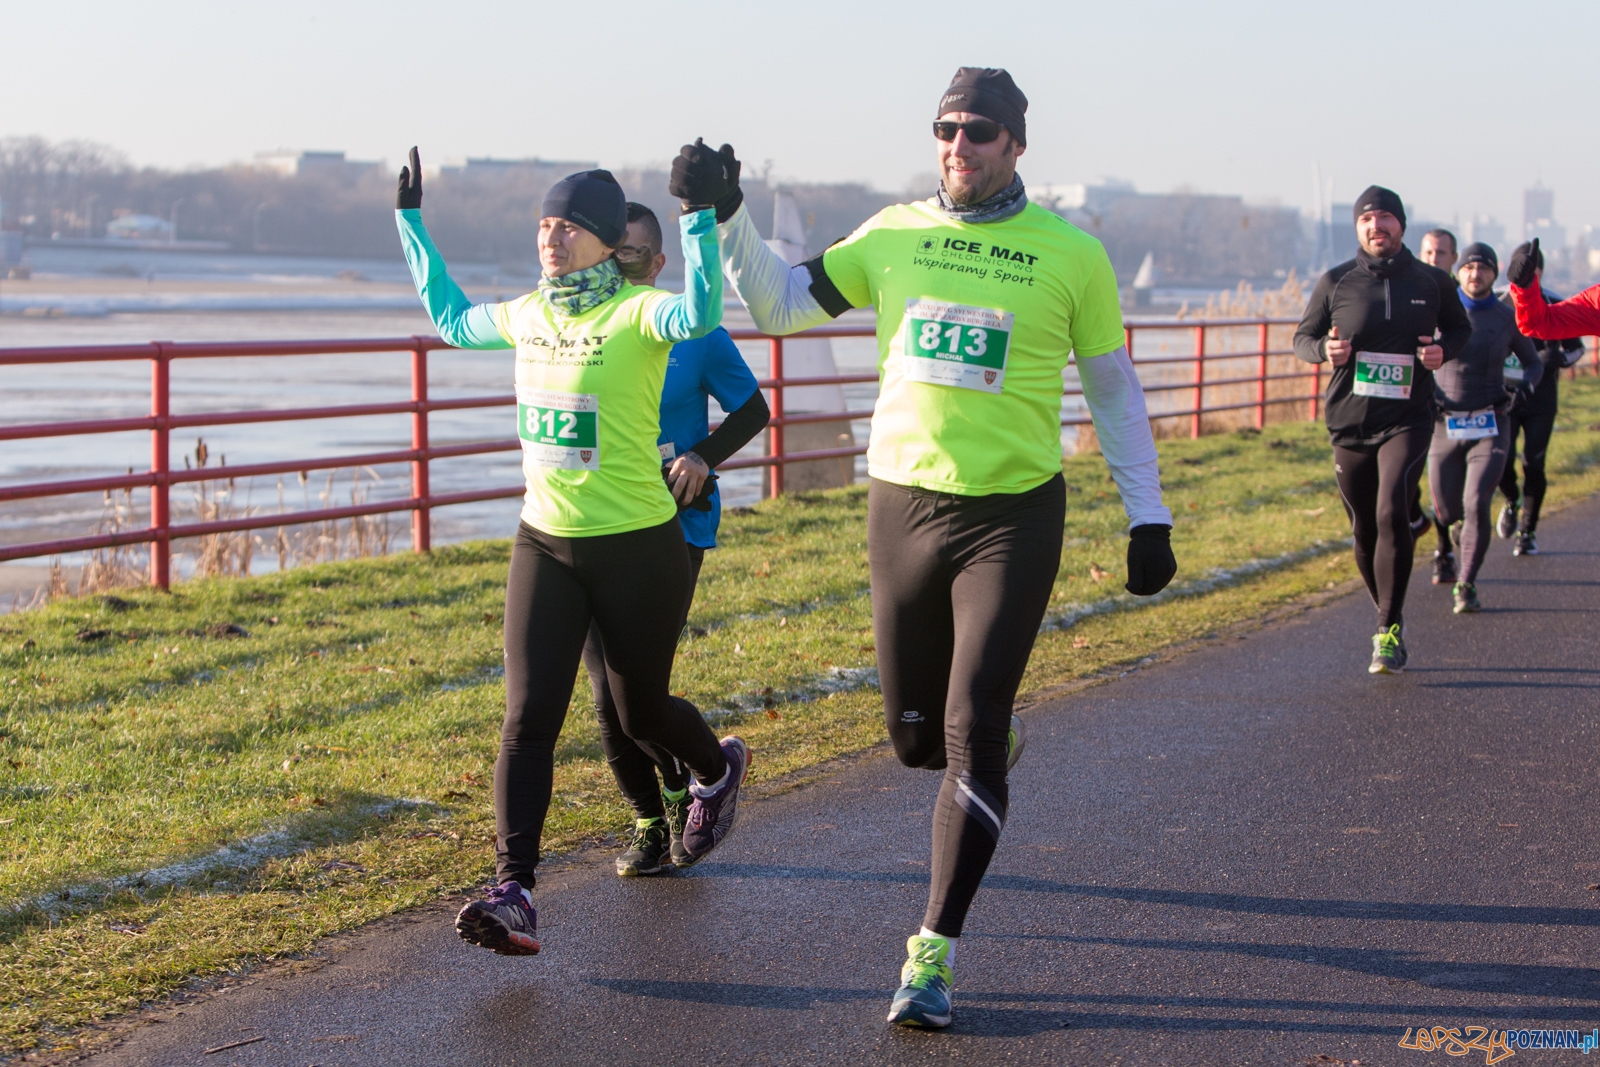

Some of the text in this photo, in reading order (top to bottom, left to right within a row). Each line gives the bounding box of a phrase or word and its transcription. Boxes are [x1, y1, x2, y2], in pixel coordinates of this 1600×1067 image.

[940, 250, 1034, 273] CHŁODNICTWO
[943, 238, 1039, 266] ICE MAT
[913, 256, 1035, 287] Wspieramy Sport
[966, 317, 1001, 328] BURGIELA
[559, 335, 608, 348] MAT
[918, 321, 988, 357] 813
[935, 352, 964, 362] MICHAŁ
[1366, 363, 1404, 382] 708
[525, 407, 578, 439] 812
[1456, 415, 1487, 427] 440
[540, 436, 557, 444] ANNA
